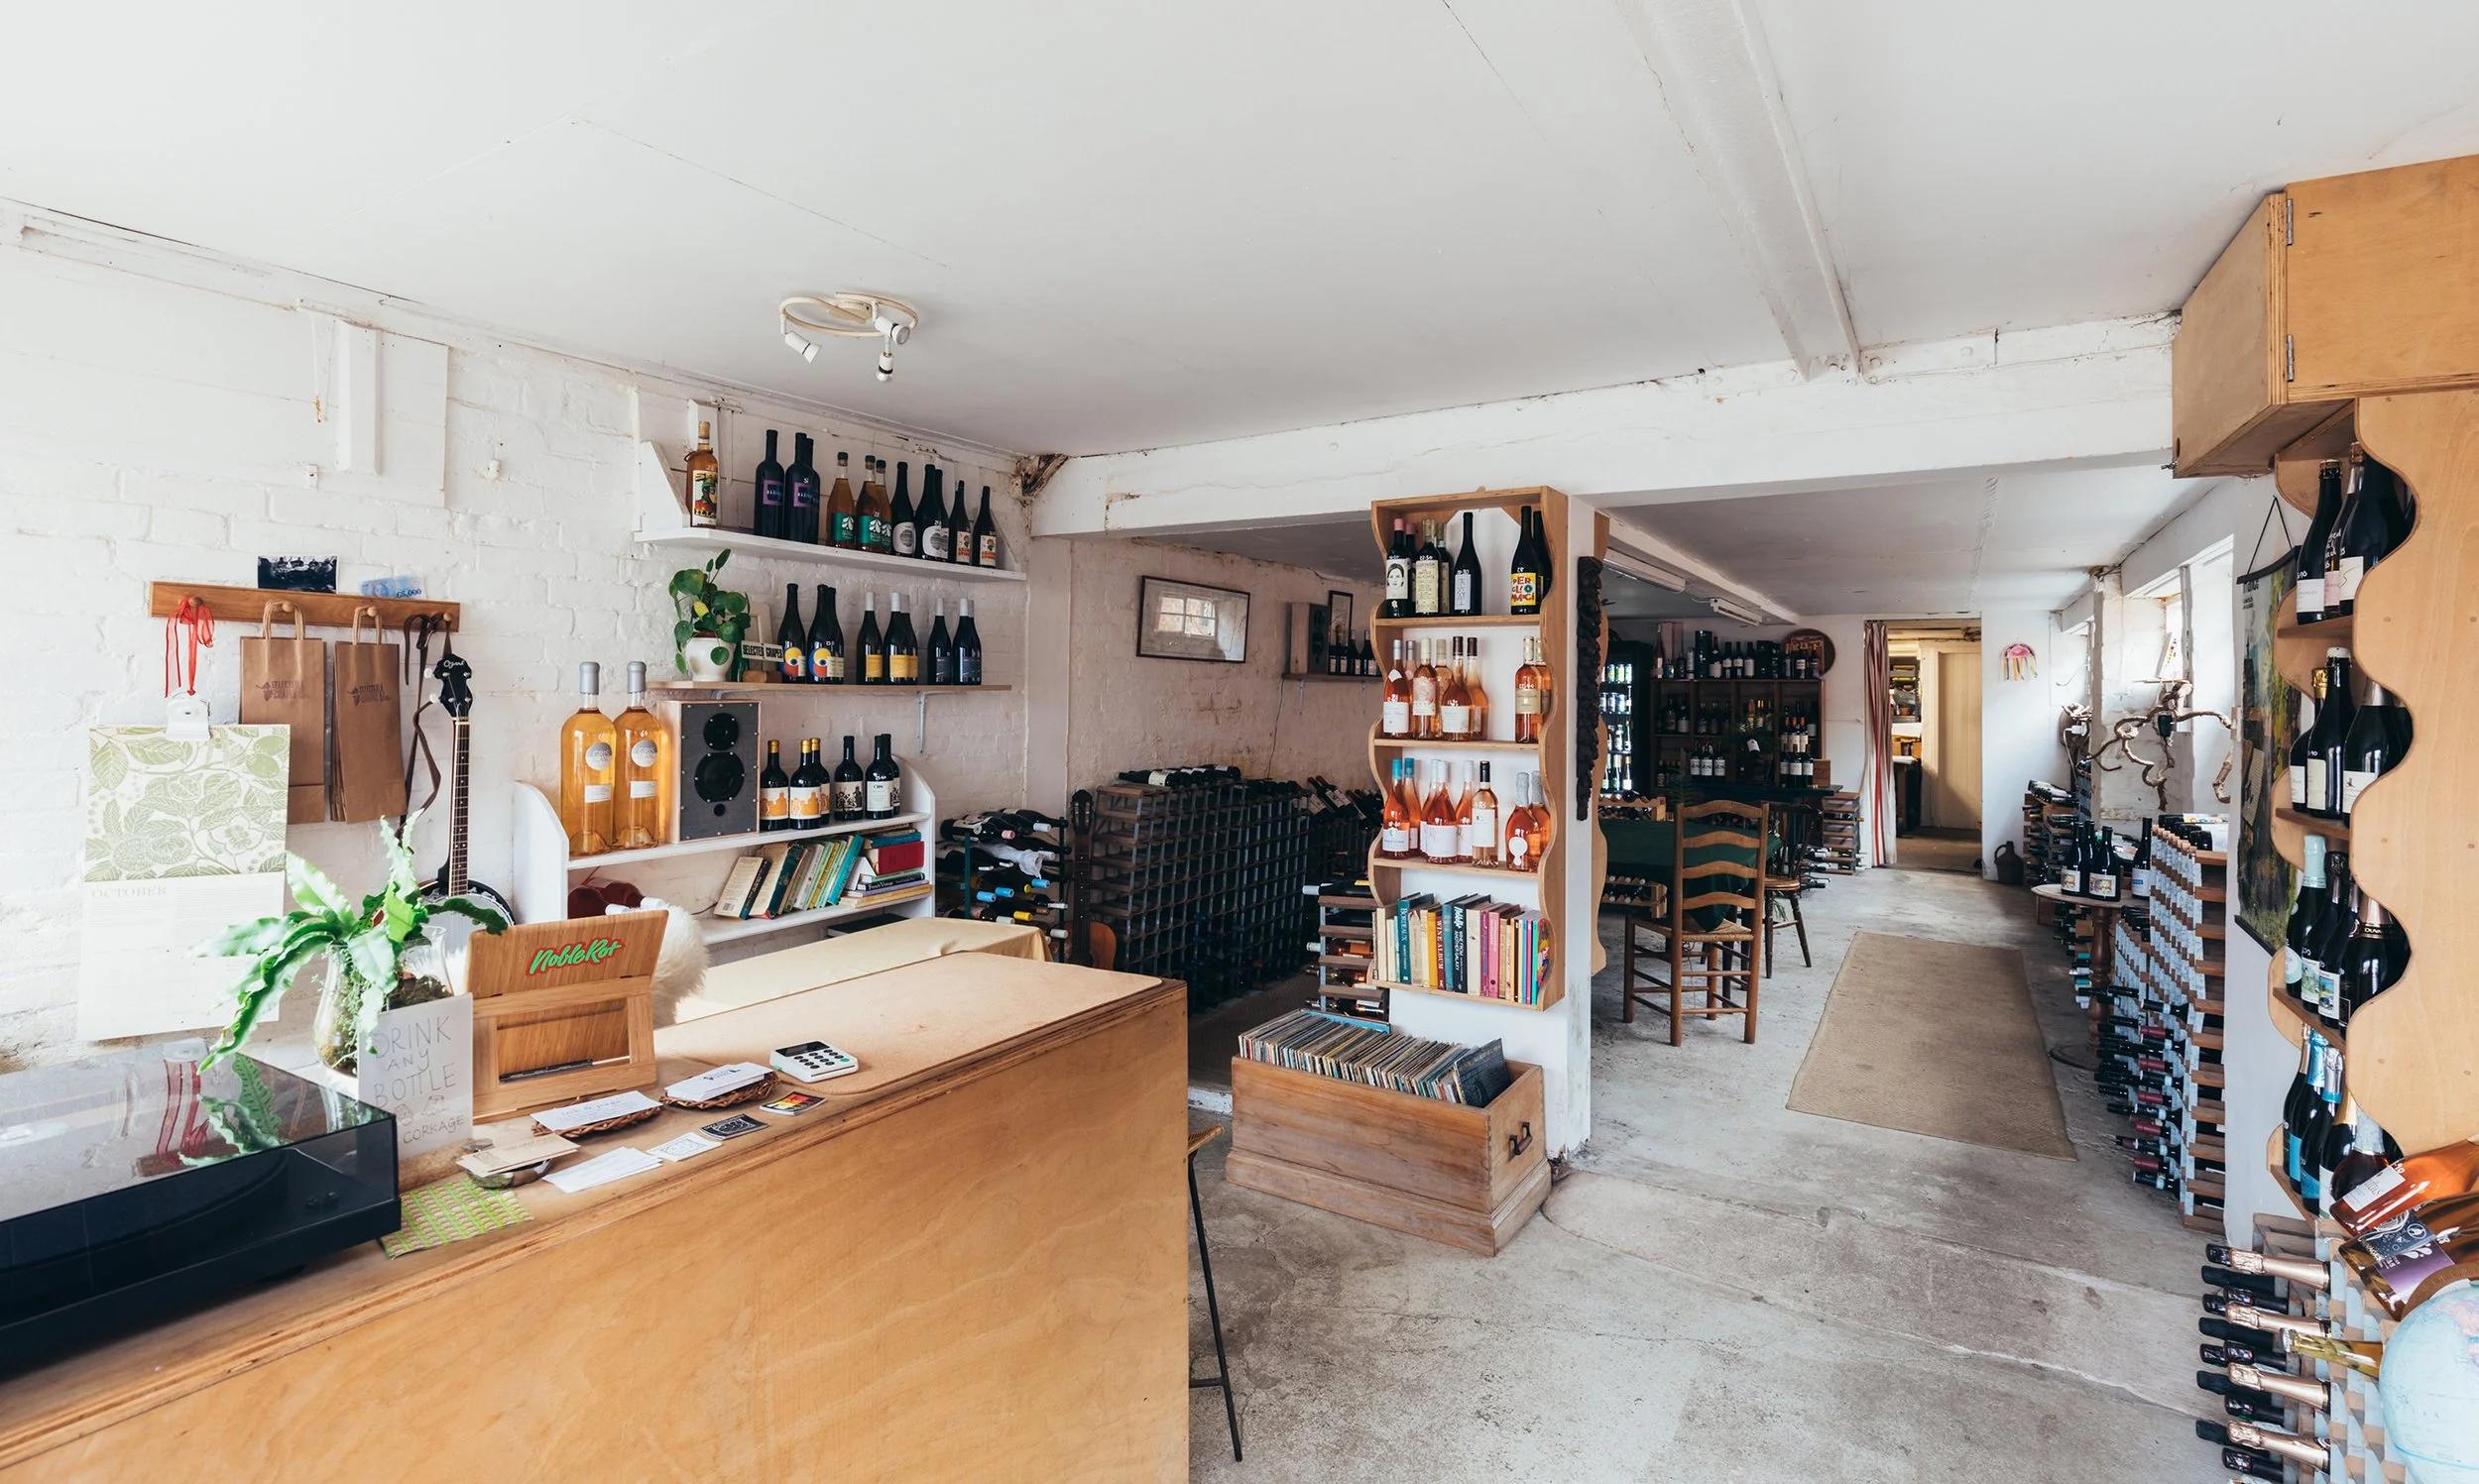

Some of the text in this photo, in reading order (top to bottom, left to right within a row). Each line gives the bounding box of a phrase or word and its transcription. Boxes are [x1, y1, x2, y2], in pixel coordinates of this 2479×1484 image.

[743, 644, 765, 657] SELECTED
[370, 1016, 452, 1059] DRINK
[386, 1048, 430, 1073] ANY
[373, 1062, 457, 1109] BOTTLE
[402, 1115, 466, 1144] CORKAGE
